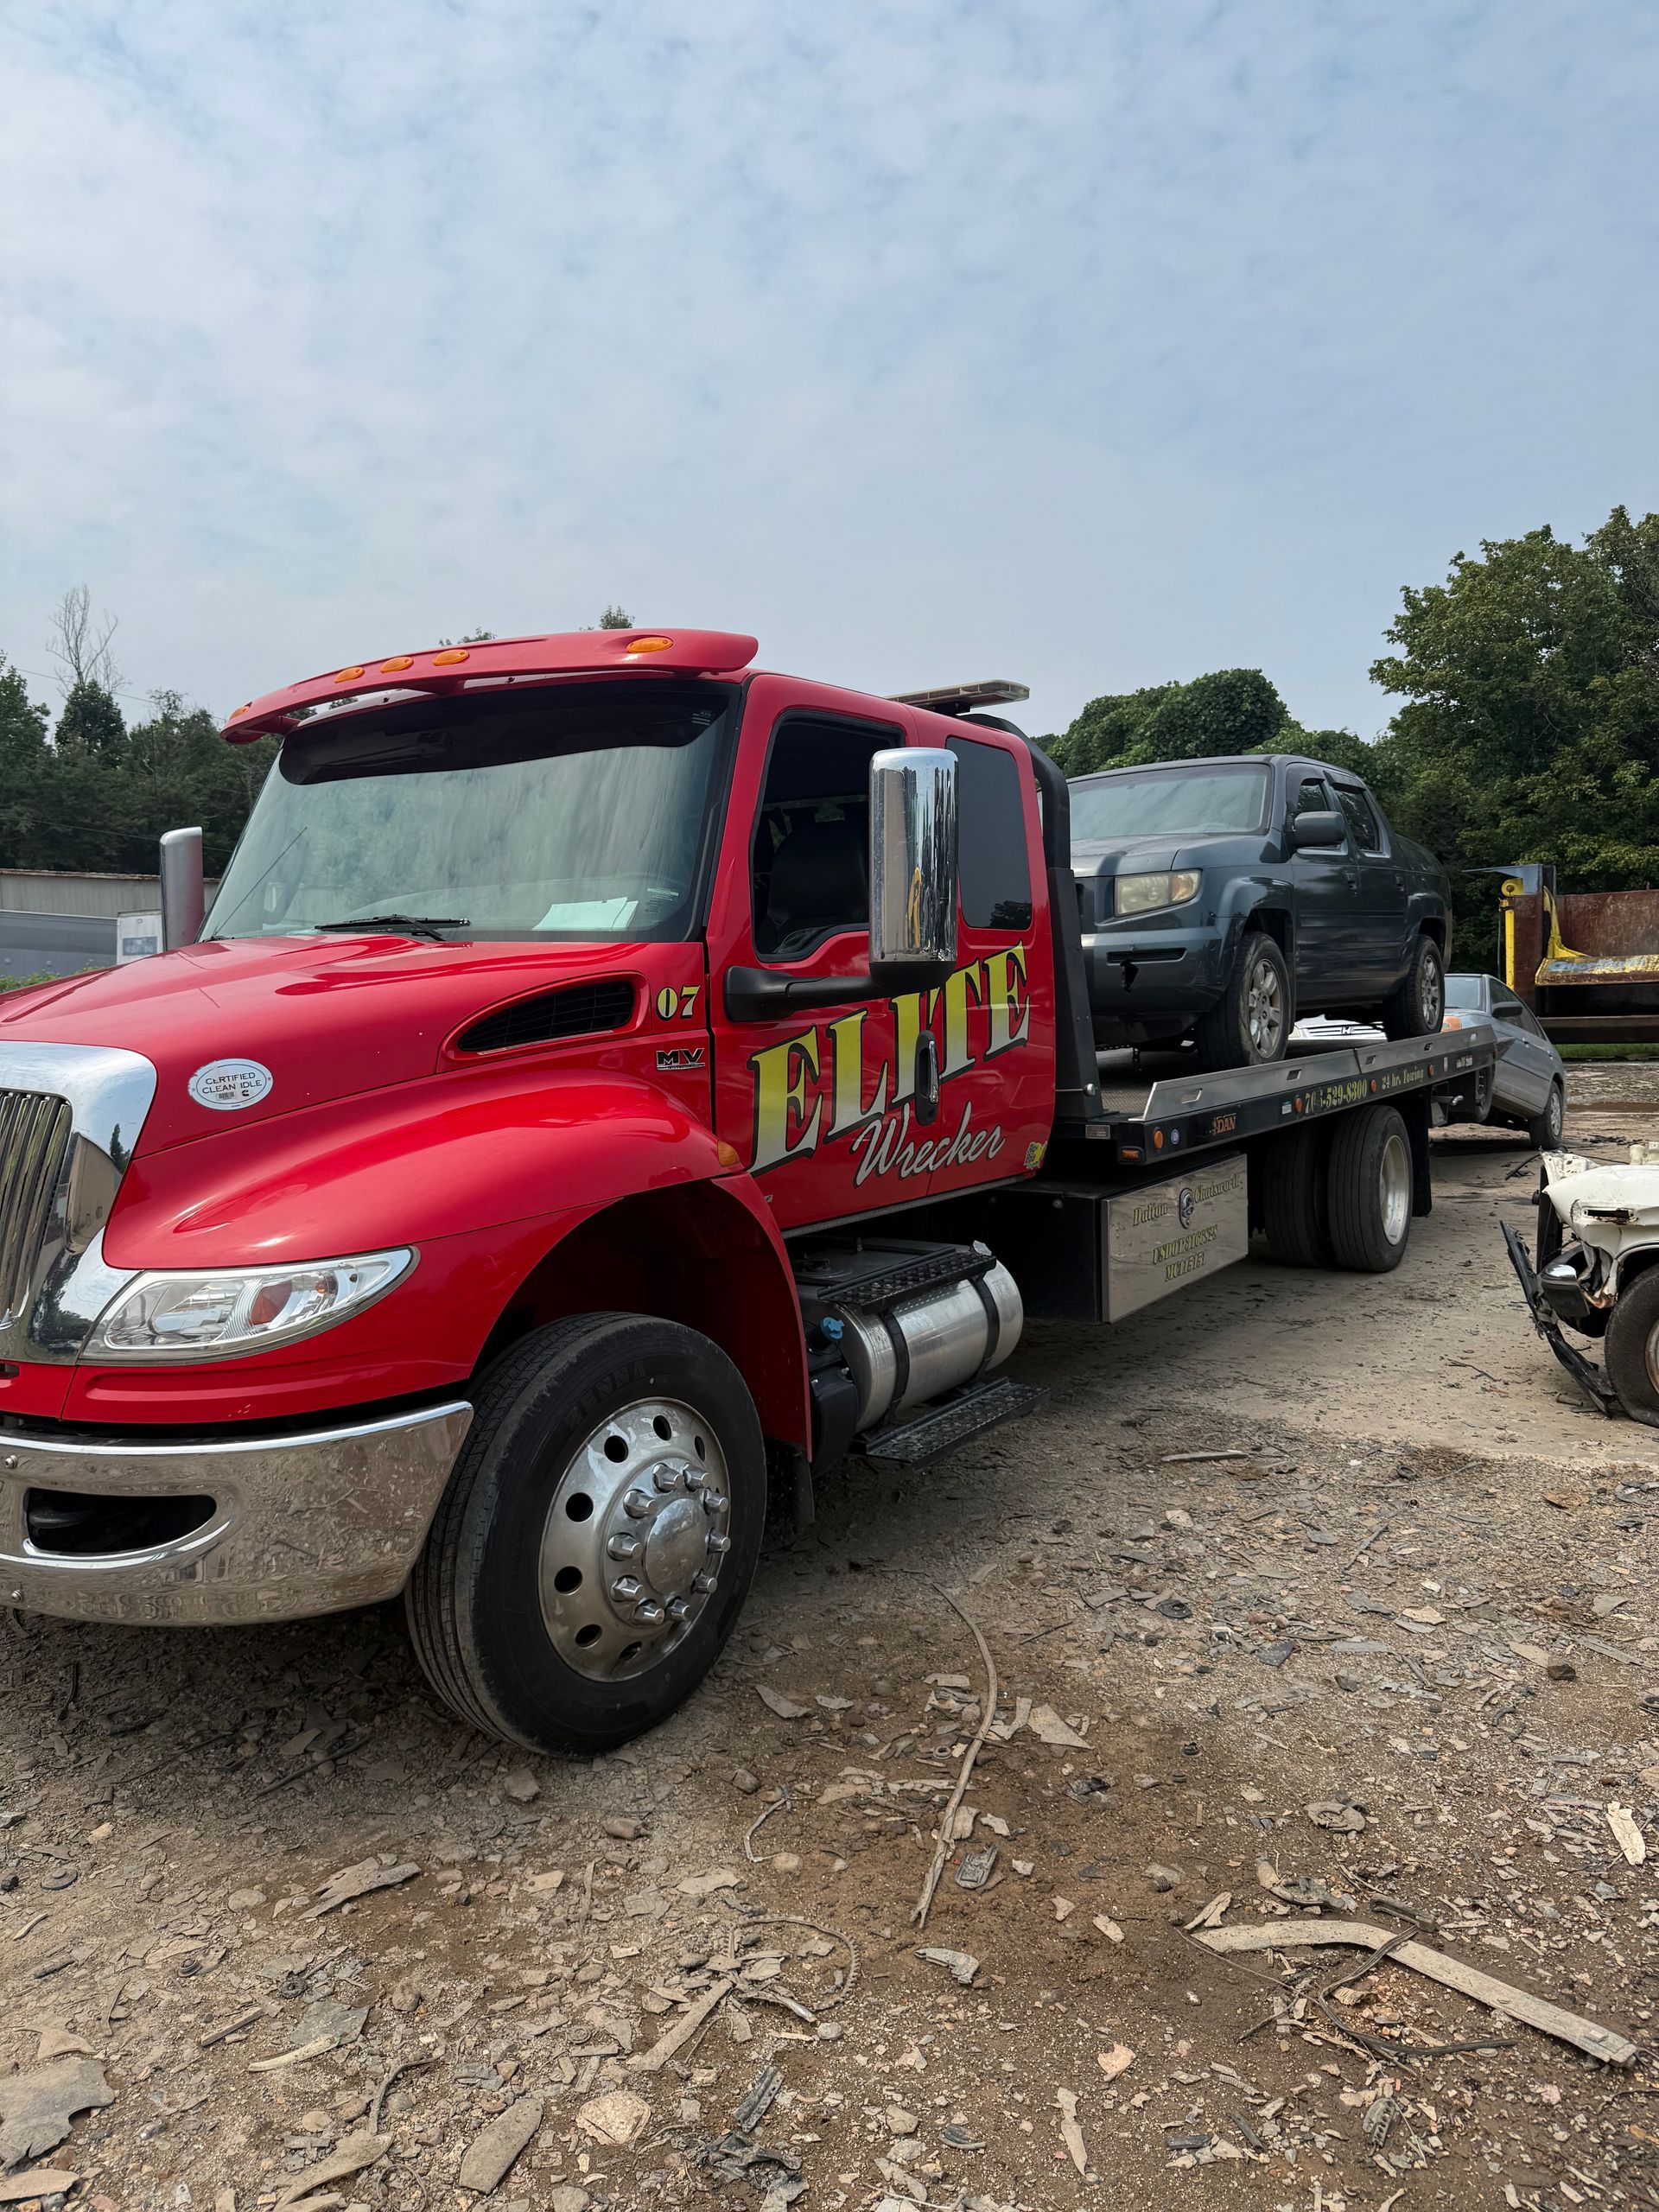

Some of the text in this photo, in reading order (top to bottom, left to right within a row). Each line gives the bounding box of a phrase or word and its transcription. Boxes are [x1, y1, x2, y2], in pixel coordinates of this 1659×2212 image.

[656, 984, 701, 1020] 07
[656, 1047, 705, 1065] MV
[747, 939, 1029, 1175] ELITE
[201, 1079, 263, 1094] CLEAN IDLE
[205, 1071, 256, 1085] CERTIFIED
[1382, 1074, 1390, 1090] 24
[1305, 1078, 1368, 1115] 70-529-8300
[849, 1100, 1006, 1187] Wrecker
[1132, 1202, 1168, 1227] Dalton
